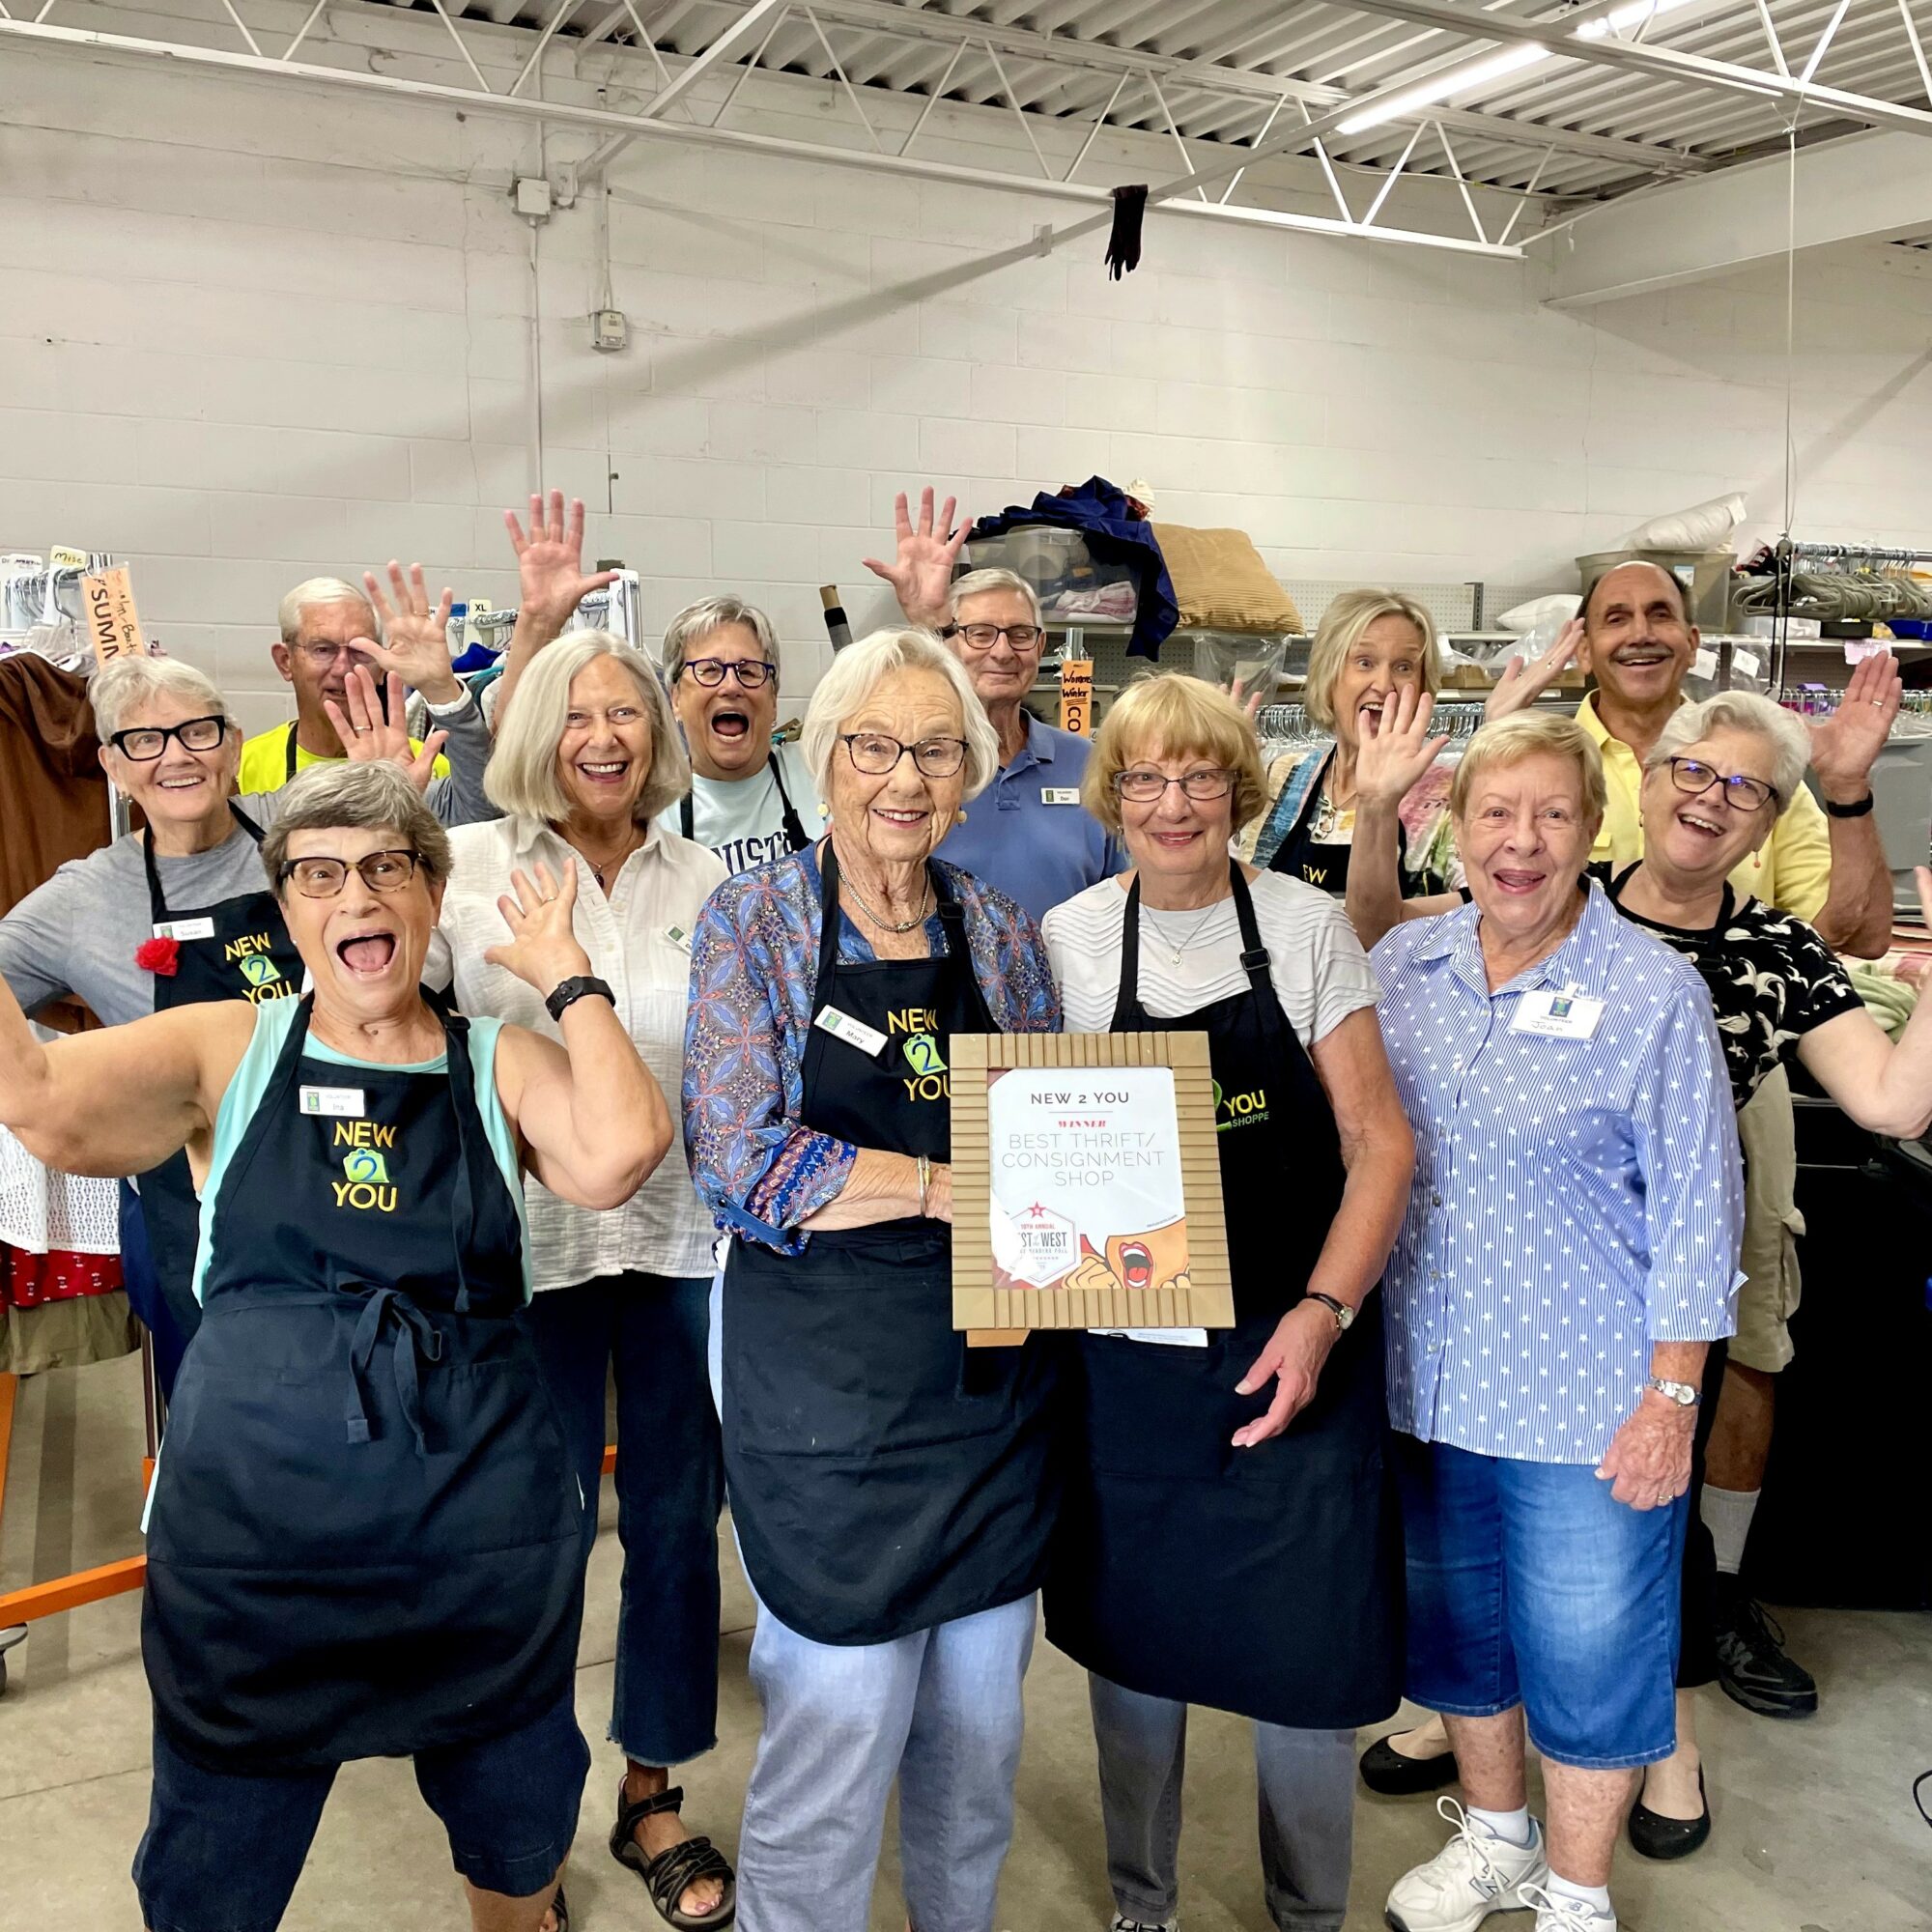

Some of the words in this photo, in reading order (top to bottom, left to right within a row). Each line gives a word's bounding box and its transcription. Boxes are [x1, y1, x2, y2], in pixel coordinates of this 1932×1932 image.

[474, 603, 487, 611] XL
[224, 932, 271, 960] NEW
[248, 959, 274, 982] 2
[242, 980, 292, 1006] YOU
[887, 1009, 939, 1034] NEW
[846, 1030, 865, 1044] Mary
[912, 1041, 940, 1071] 2
[1031, 1093, 1071, 1104] NEW
[1078, 1094, 1087, 1104] 2
[1094, 1092, 1129, 1103] YOU
[1222, 1089, 1266, 1117] YOU
[1232, 1111, 1269, 1127] SHOPPE
[333, 1121, 397, 1149] NEW
[1009, 1133, 1062, 1149] BEST
[1069, 1132, 1155, 1148] THRIFT/
[353, 1155, 377, 1180] 2
[1002, 1151, 1165, 1168] CONSIGNMENT
[1055, 1170, 1114, 1186] SHOP
[331, 1181, 397, 1212] YOU
[1040, 1232, 1067, 1247] WEST
